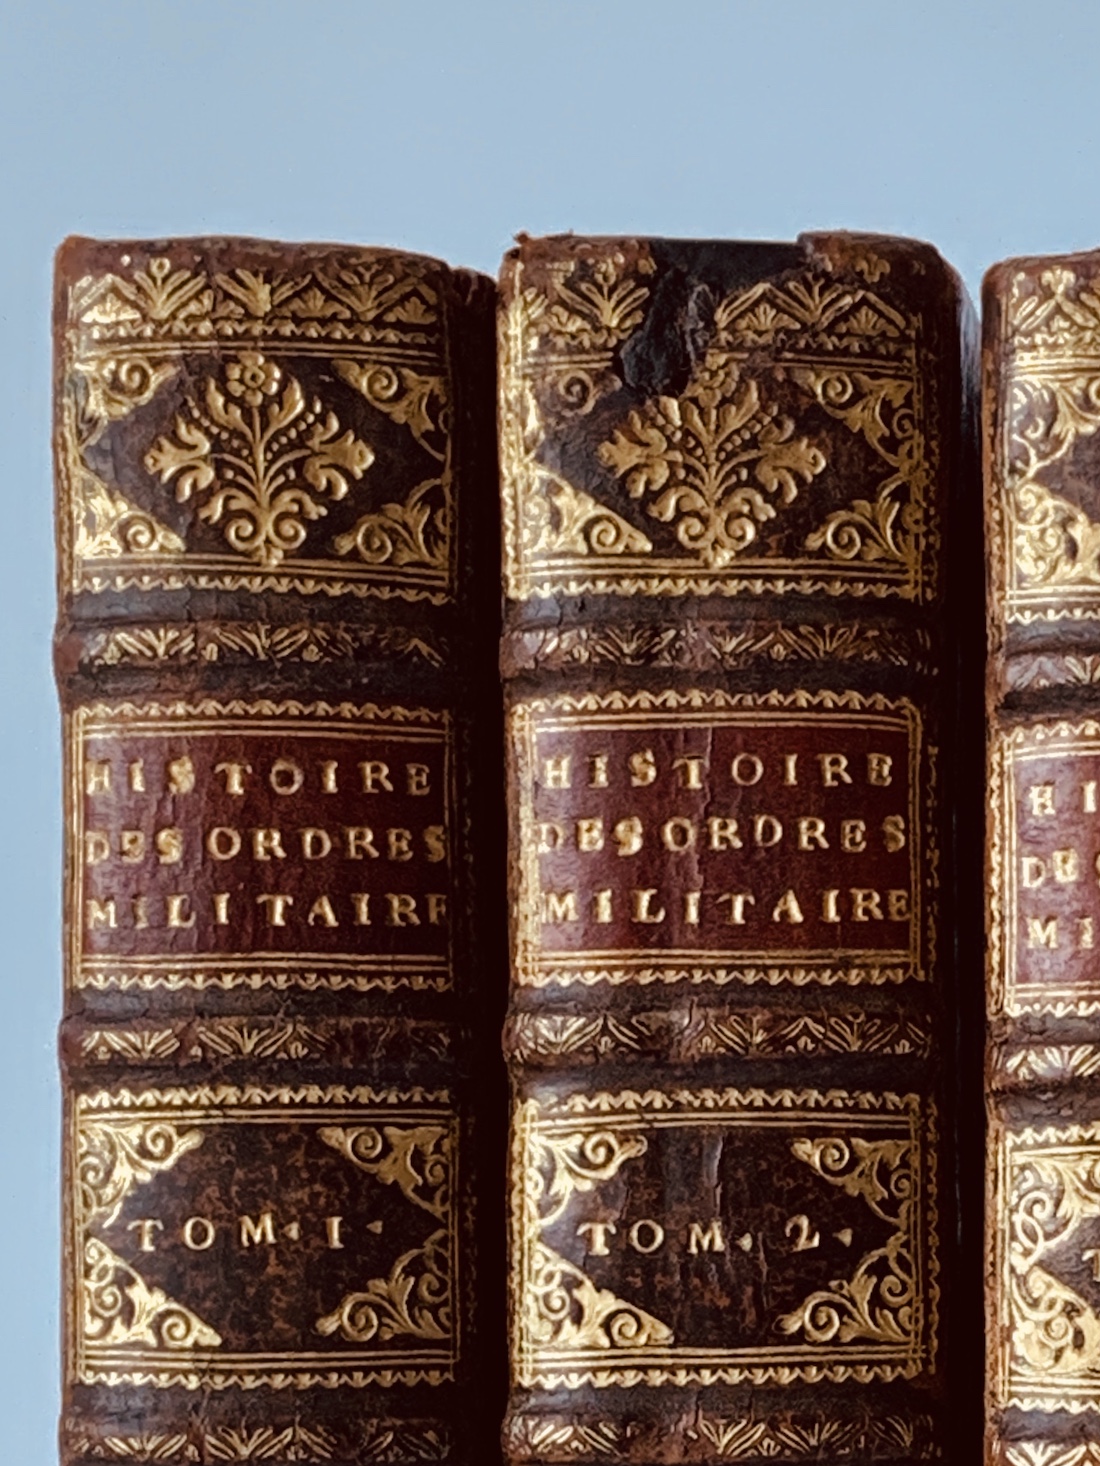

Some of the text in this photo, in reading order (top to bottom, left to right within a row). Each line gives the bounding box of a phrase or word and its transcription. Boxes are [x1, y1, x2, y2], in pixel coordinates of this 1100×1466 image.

[86, 755, 431, 795] HISTOIRE
[544, 749, 893, 790] HISTOIRE
[85, 825, 446, 864] DES ORDRES
[535, 814, 906, 855] DES ORDRES
[541, 888, 909, 924] MILITAIRE
